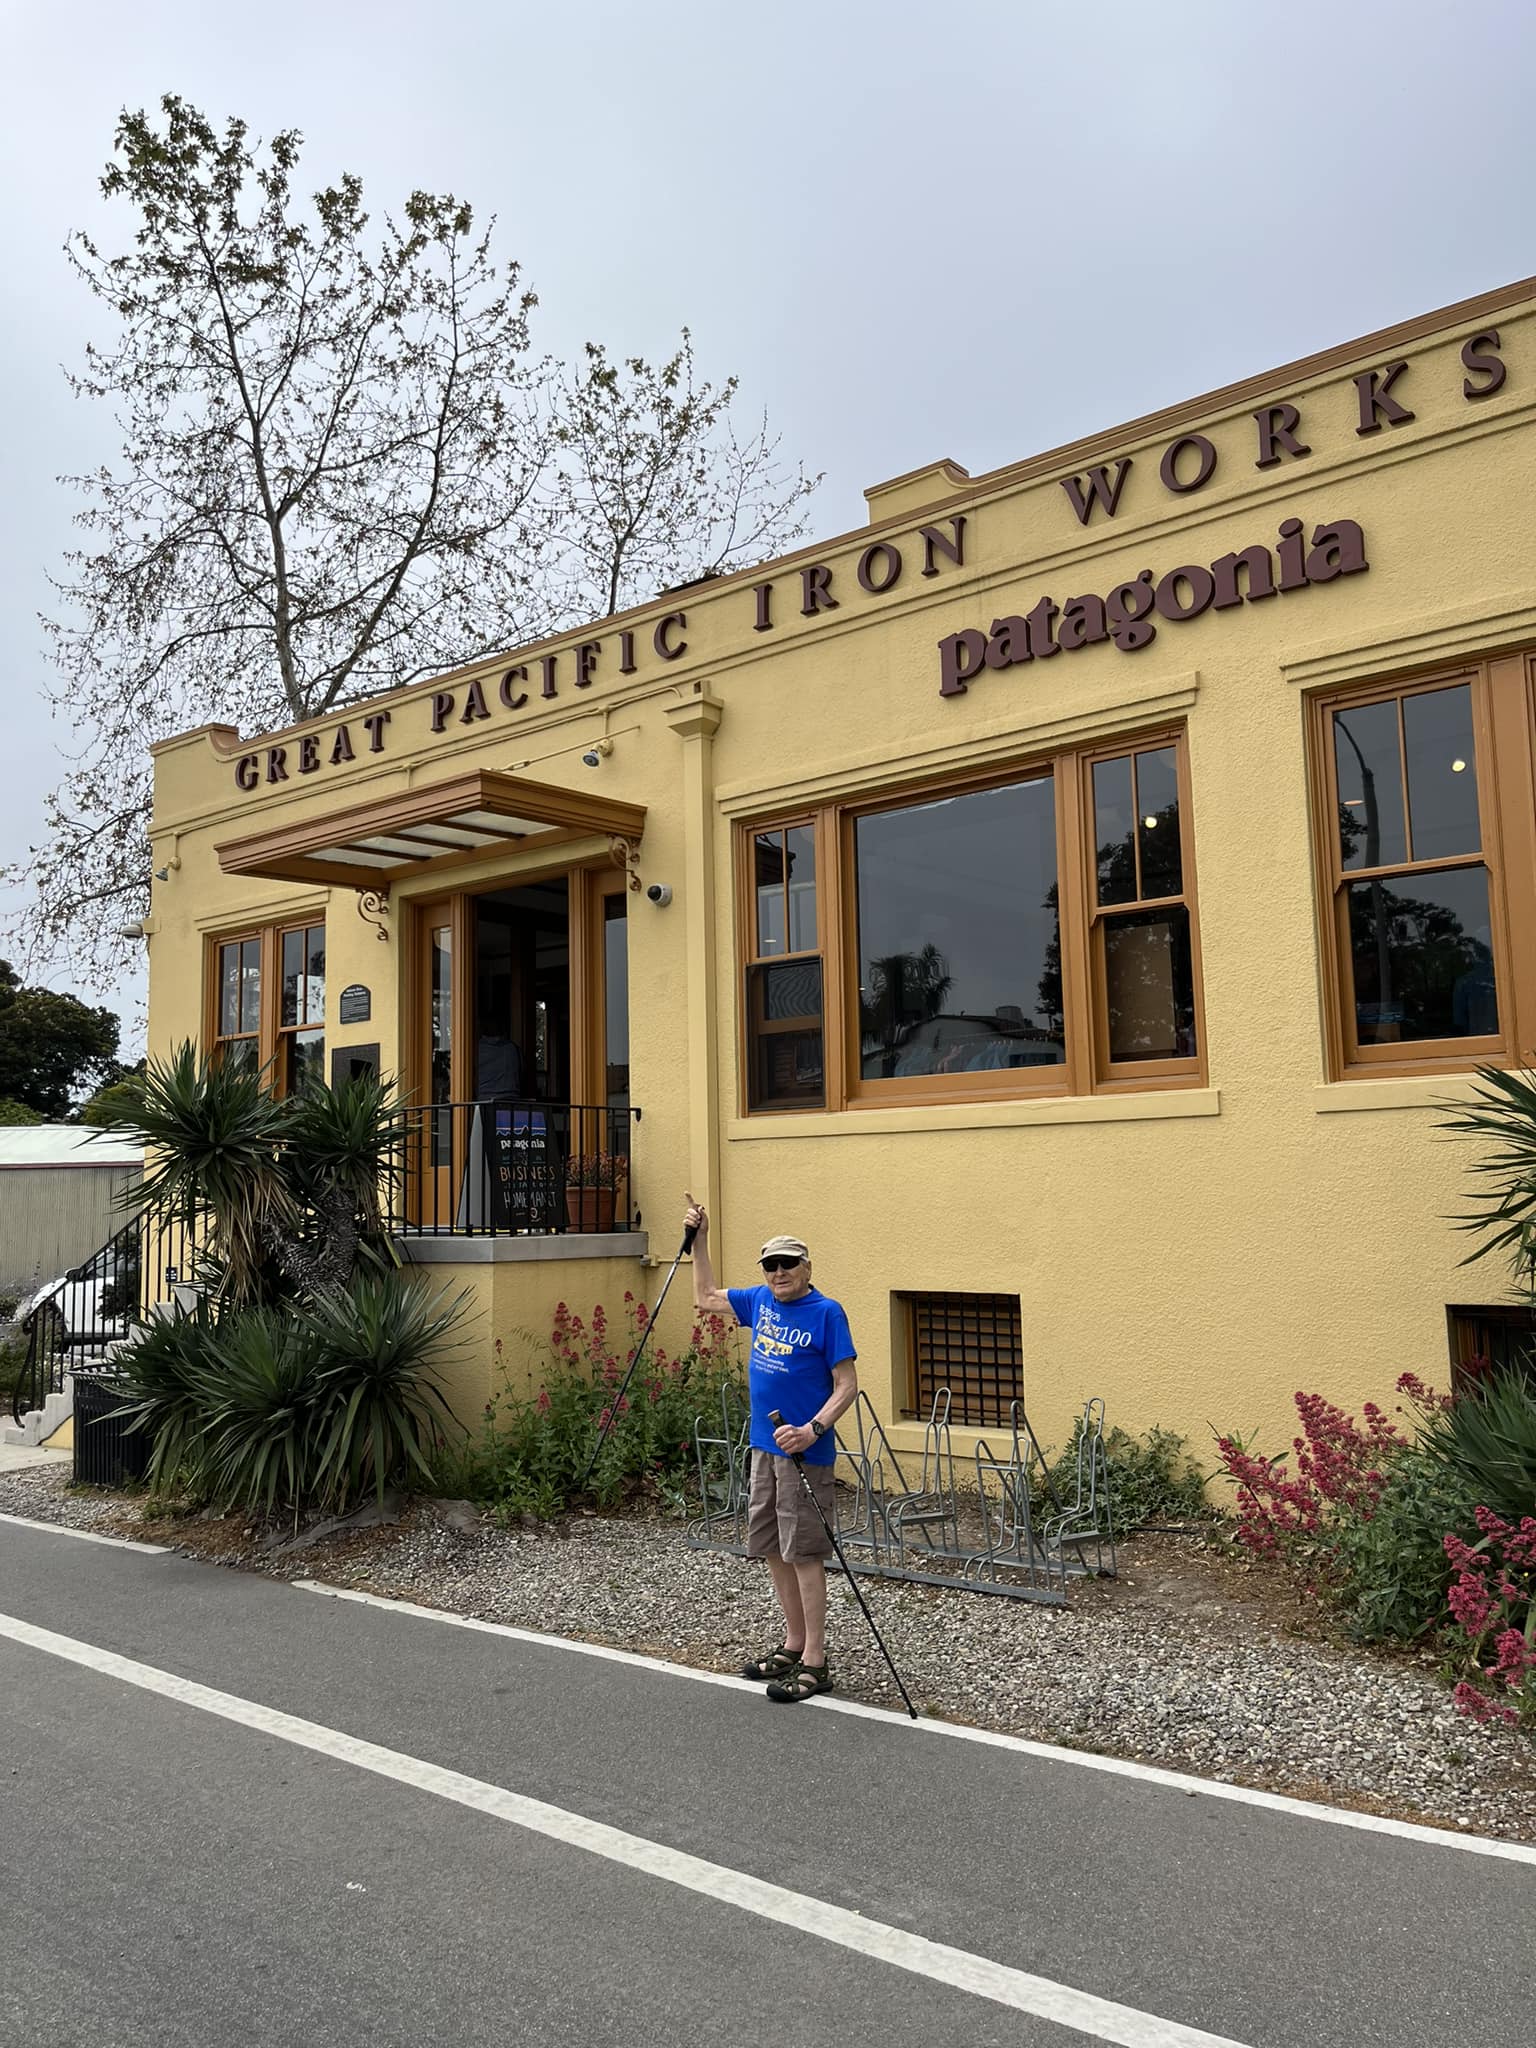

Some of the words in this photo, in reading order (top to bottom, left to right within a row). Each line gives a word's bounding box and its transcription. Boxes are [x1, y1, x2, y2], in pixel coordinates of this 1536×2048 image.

[234, 710, 392, 791] GREAT
[430, 612, 689, 733] PACIFIC
[751, 516, 968, 632] IRON
[1058, 330, 1507, 526] WORKS
[937, 517, 1370, 698] patagonia
[500, 1139, 546, 1150] paagnia
